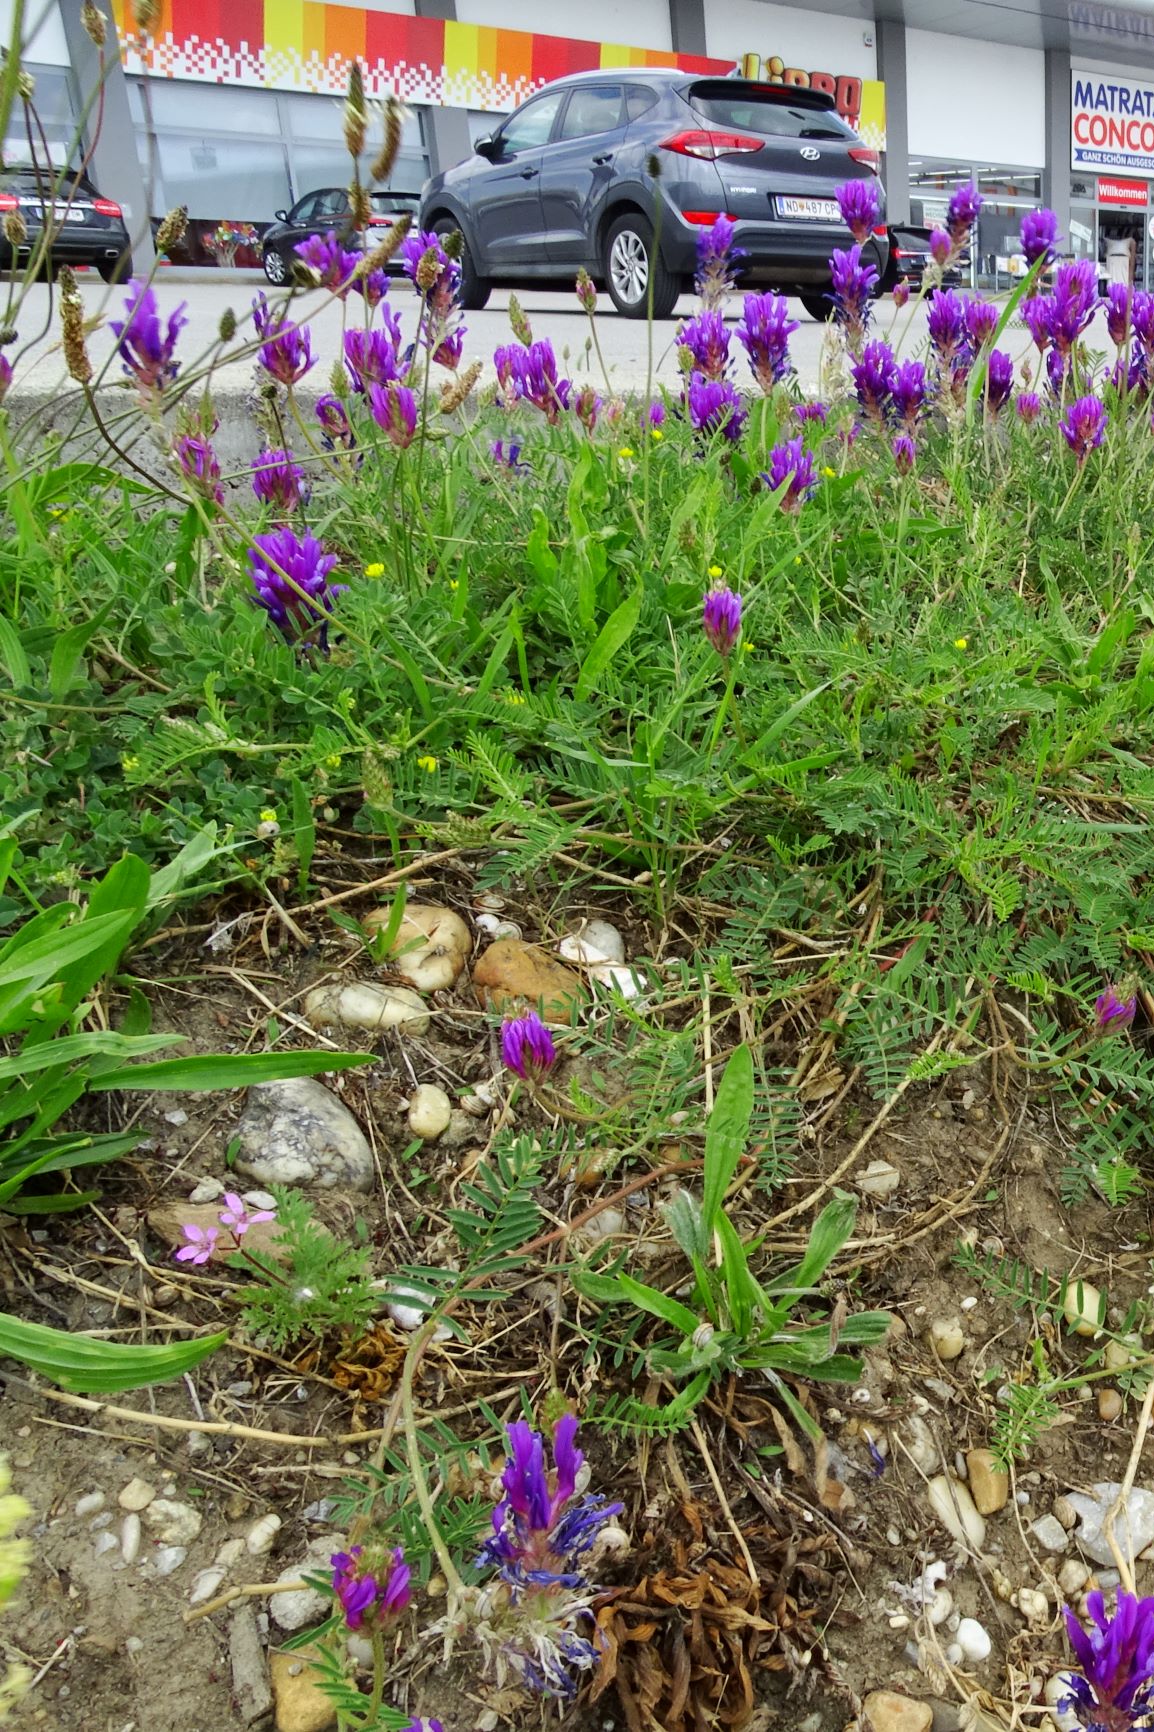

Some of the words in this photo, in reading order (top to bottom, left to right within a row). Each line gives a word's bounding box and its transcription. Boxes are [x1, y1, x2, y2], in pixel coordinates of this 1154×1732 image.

[1082, 151, 1102, 162] GANZ
[1102, 153, 1127, 165] SCHÖN
[1099, 184, 1148, 199] Willkommen
[786, 201, 799, 213] ND
